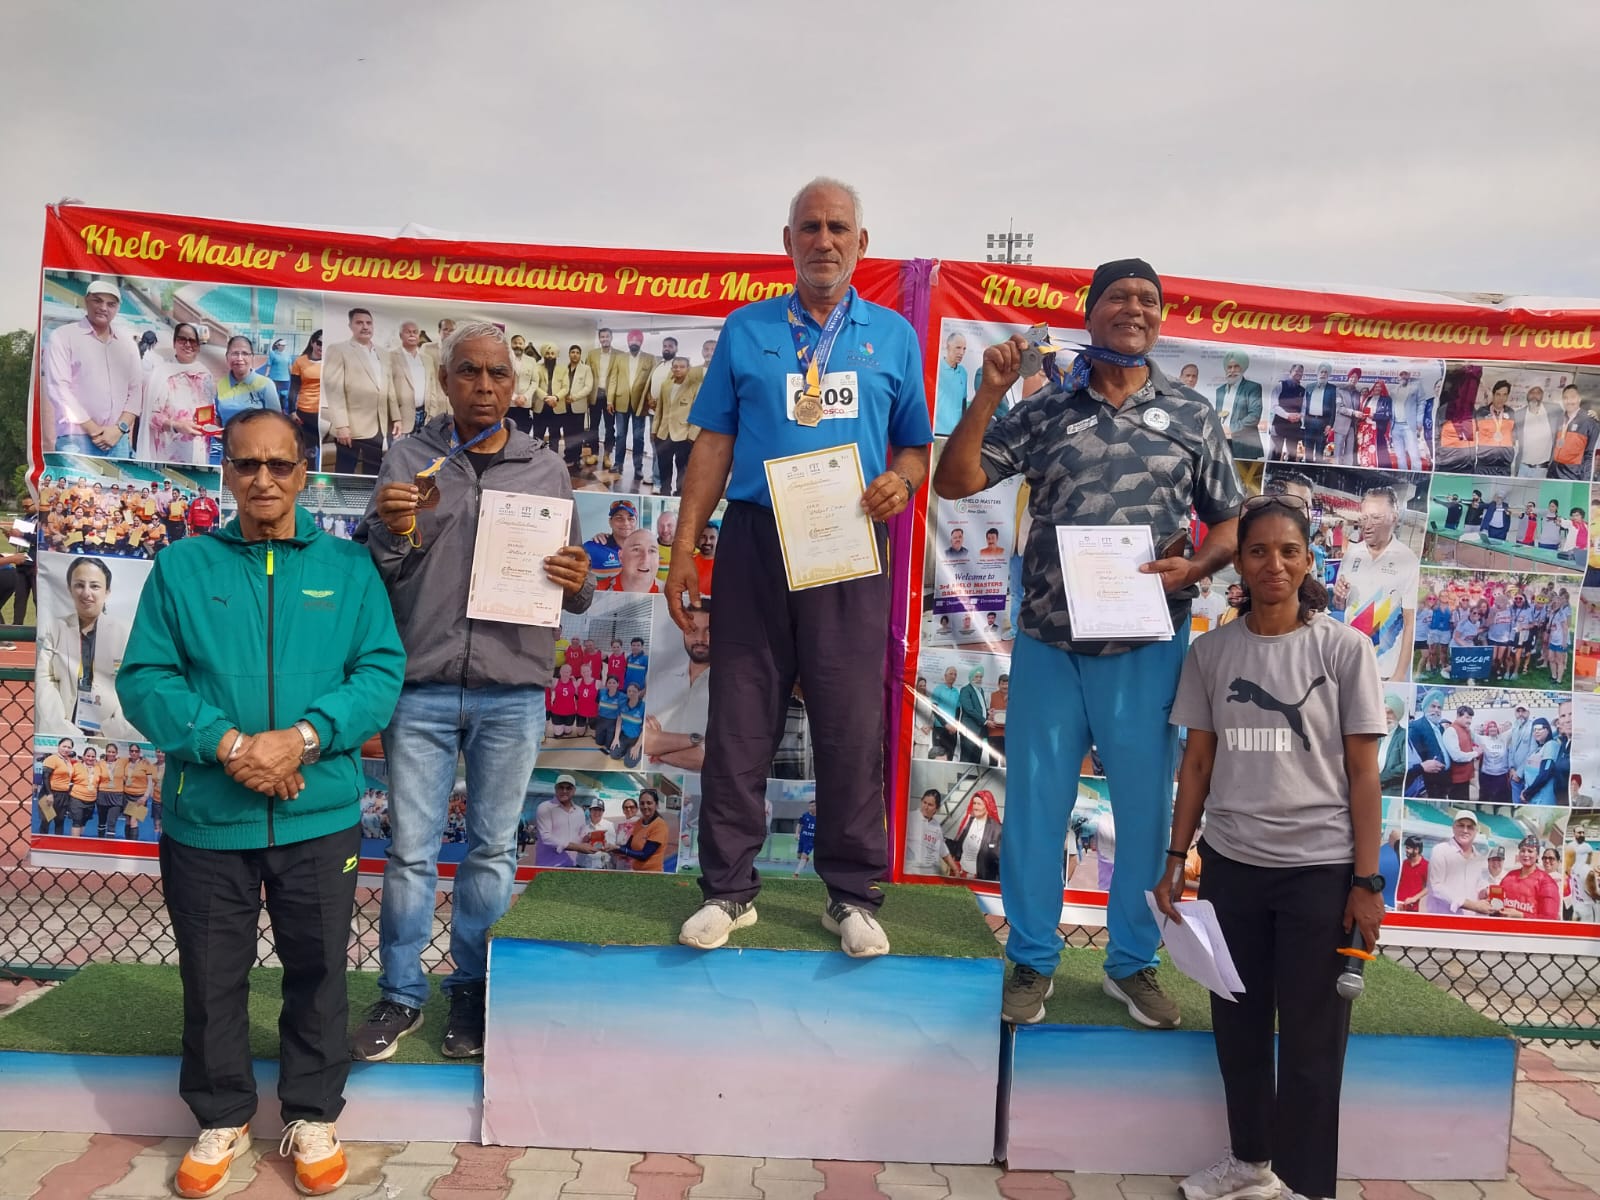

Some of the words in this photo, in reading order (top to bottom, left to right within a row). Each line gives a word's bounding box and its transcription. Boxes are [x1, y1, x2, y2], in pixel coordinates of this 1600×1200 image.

[80, 224, 171, 260] Khelo
[177, 233, 313, 272] Master's
[320, 249, 424, 282] Games
[431, 255, 607, 295] Foundation
[614, 267, 711, 300] Proud
[719, 271, 795, 302] Mom
[981, 274, 1069, 311] Khelo
[1211, 300, 1313, 335] Games
[955, 573, 986, 581] Welcome
[612, 659, 621, 668] 12
[1455, 655, 1491, 664] SOCCER
[562, 687, 569, 697] 5
[582, 688, 589, 698] 8
[1225, 727, 1292, 752] PUMA
